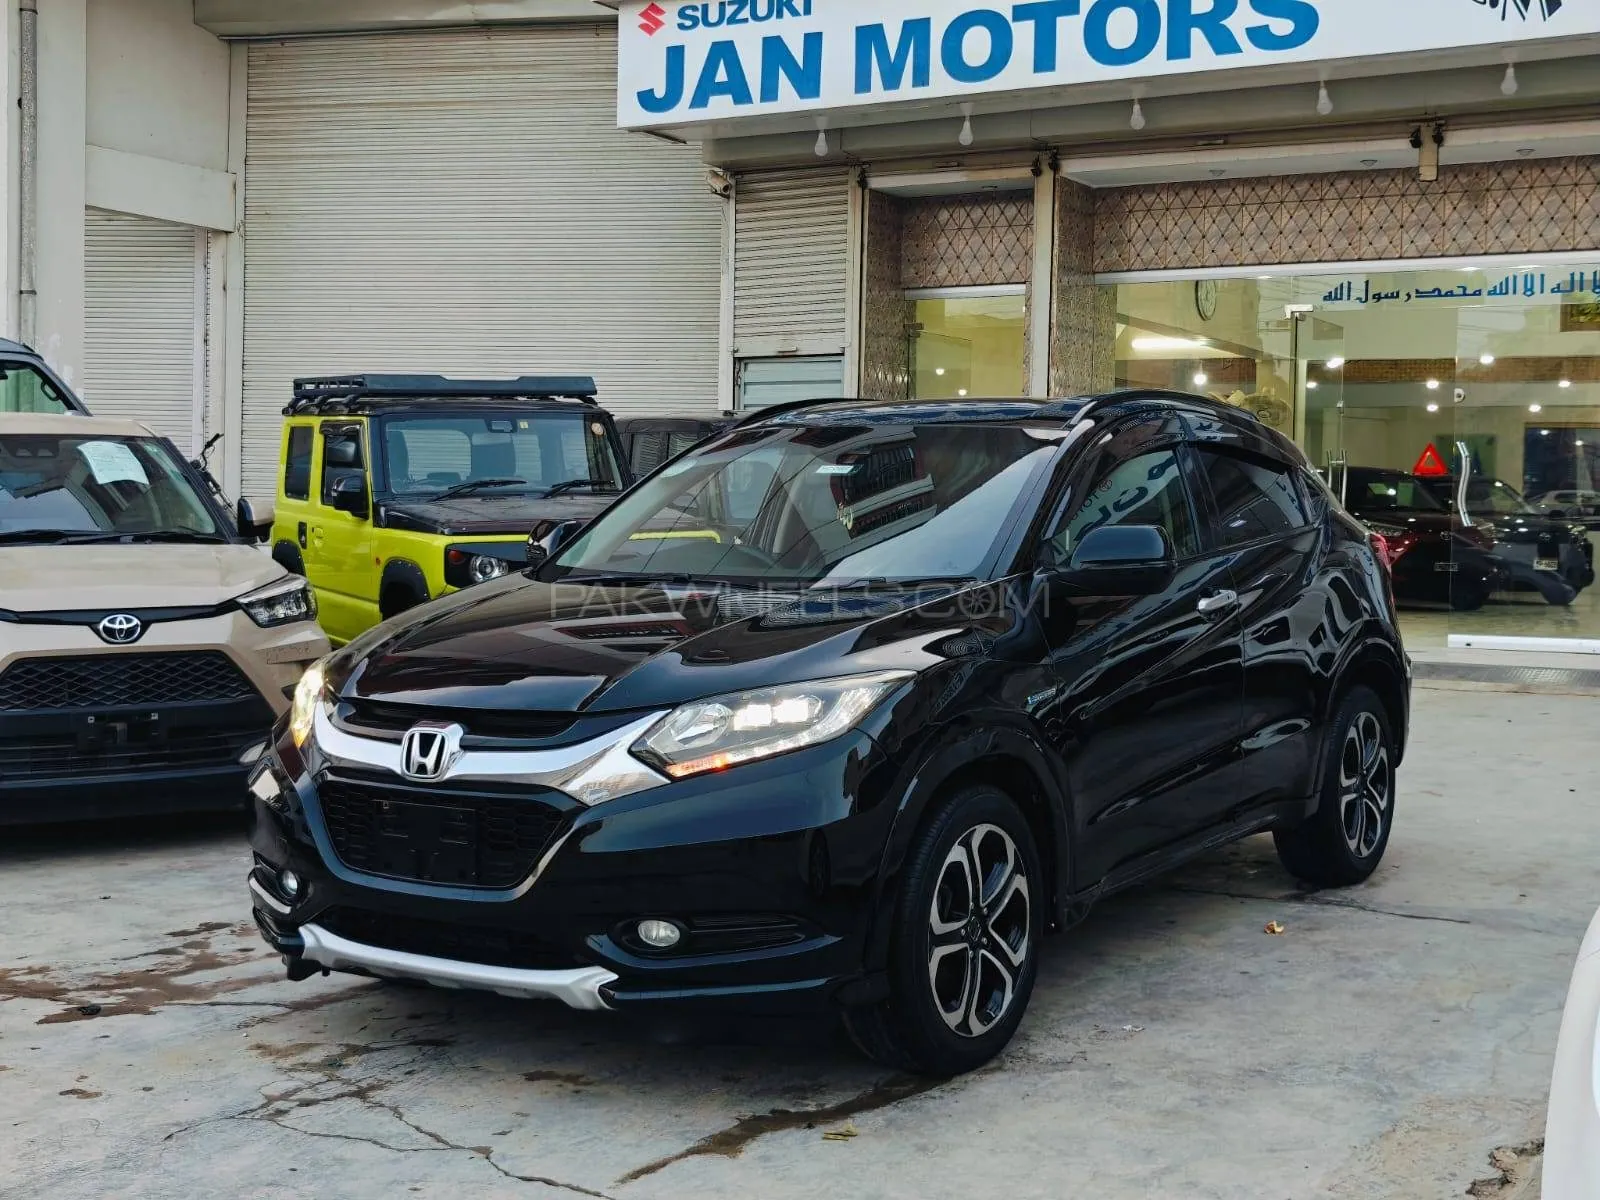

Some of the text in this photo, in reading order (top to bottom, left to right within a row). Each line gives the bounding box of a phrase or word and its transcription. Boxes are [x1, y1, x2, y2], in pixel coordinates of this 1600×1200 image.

[676, 0, 813, 33] SUZUKI
[635, 0, 1321, 115] JAN MOTORS
[1415, 285, 1483, 298] محمد
